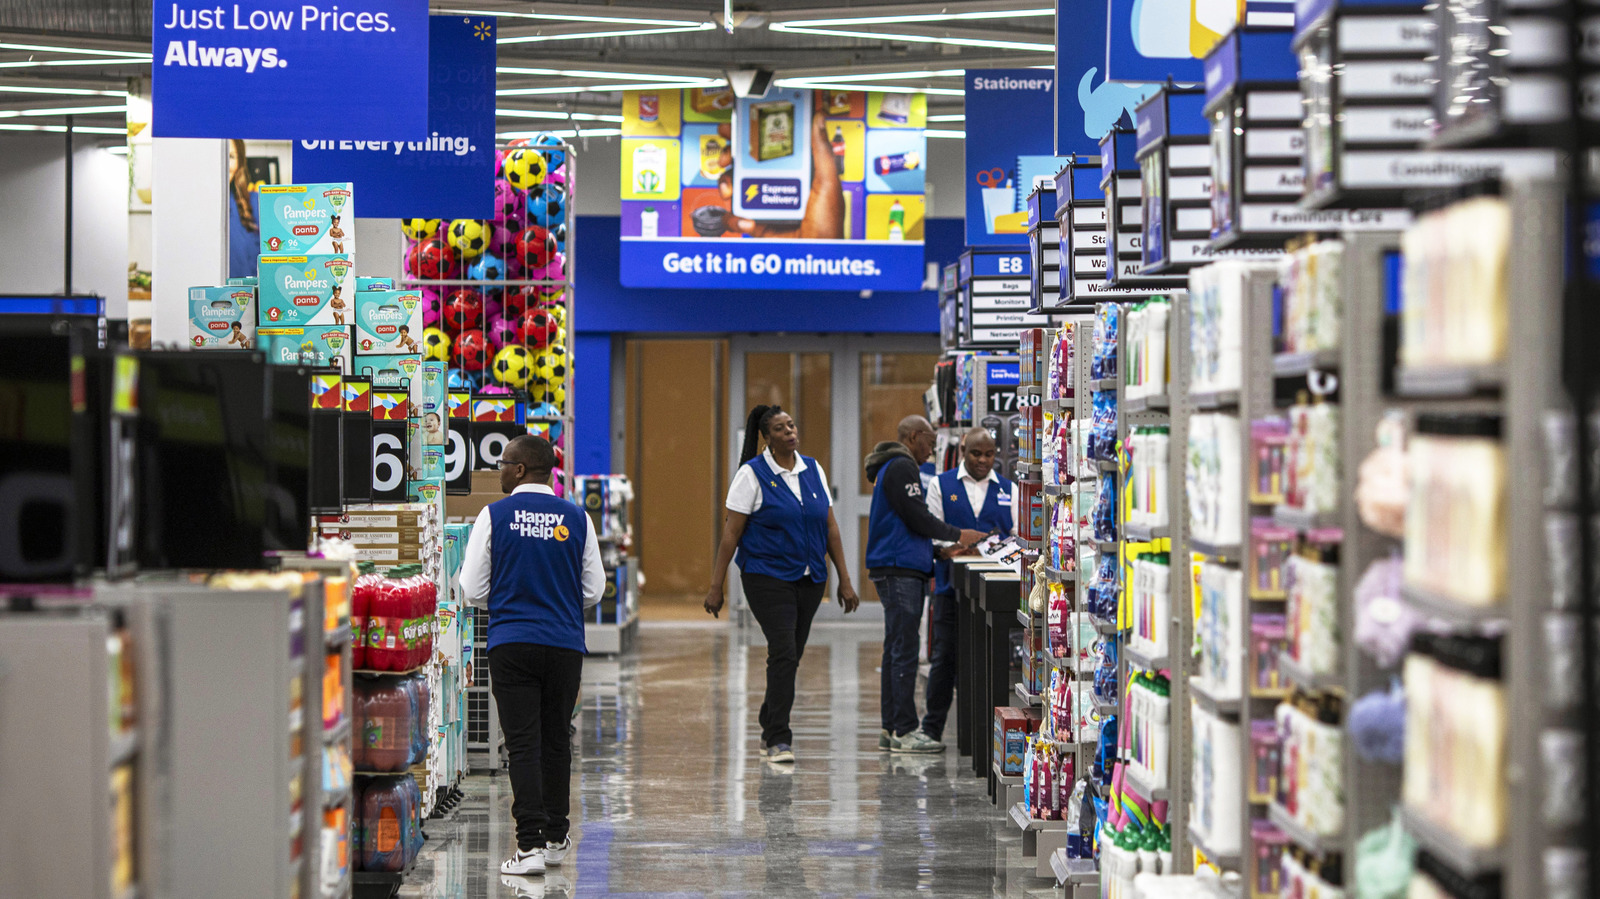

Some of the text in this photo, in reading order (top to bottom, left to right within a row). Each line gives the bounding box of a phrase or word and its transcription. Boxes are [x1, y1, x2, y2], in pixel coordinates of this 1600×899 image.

[164, 3, 396, 33] Just Low Prices.
[163, 40, 288, 74] Always.
[973, 76, 1053, 93] Stationery
[761, 183, 798, 196] Express
[761, 194, 800, 206] Delivery
[283, 204, 327, 220] Pampers
[295, 225, 317, 235] pants
[270, 238, 278, 248] 6
[287, 238, 298, 247] 96
[662, 252, 882, 276] Get it in 60 minutes.
[998, 257, 1024, 273] E8
[284, 274, 328, 291] Pampers
[1002, 283, 1019, 291] Bags
[296, 296, 318, 306] pants
[201, 305, 236, 317] Pampers
[270, 308, 278, 318] 6
[287, 309, 298, 317] 96
[368, 309, 403, 323] Pampers
[210, 322, 228, 330] pants
[377, 325, 395, 334] pants
[195, 336, 202, 344] 4
[363, 340, 370, 348] 4
[372, 433, 404, 492] 6
[514, 509, 565, 527] Happy
[509, 522, 554, 540] to Help
